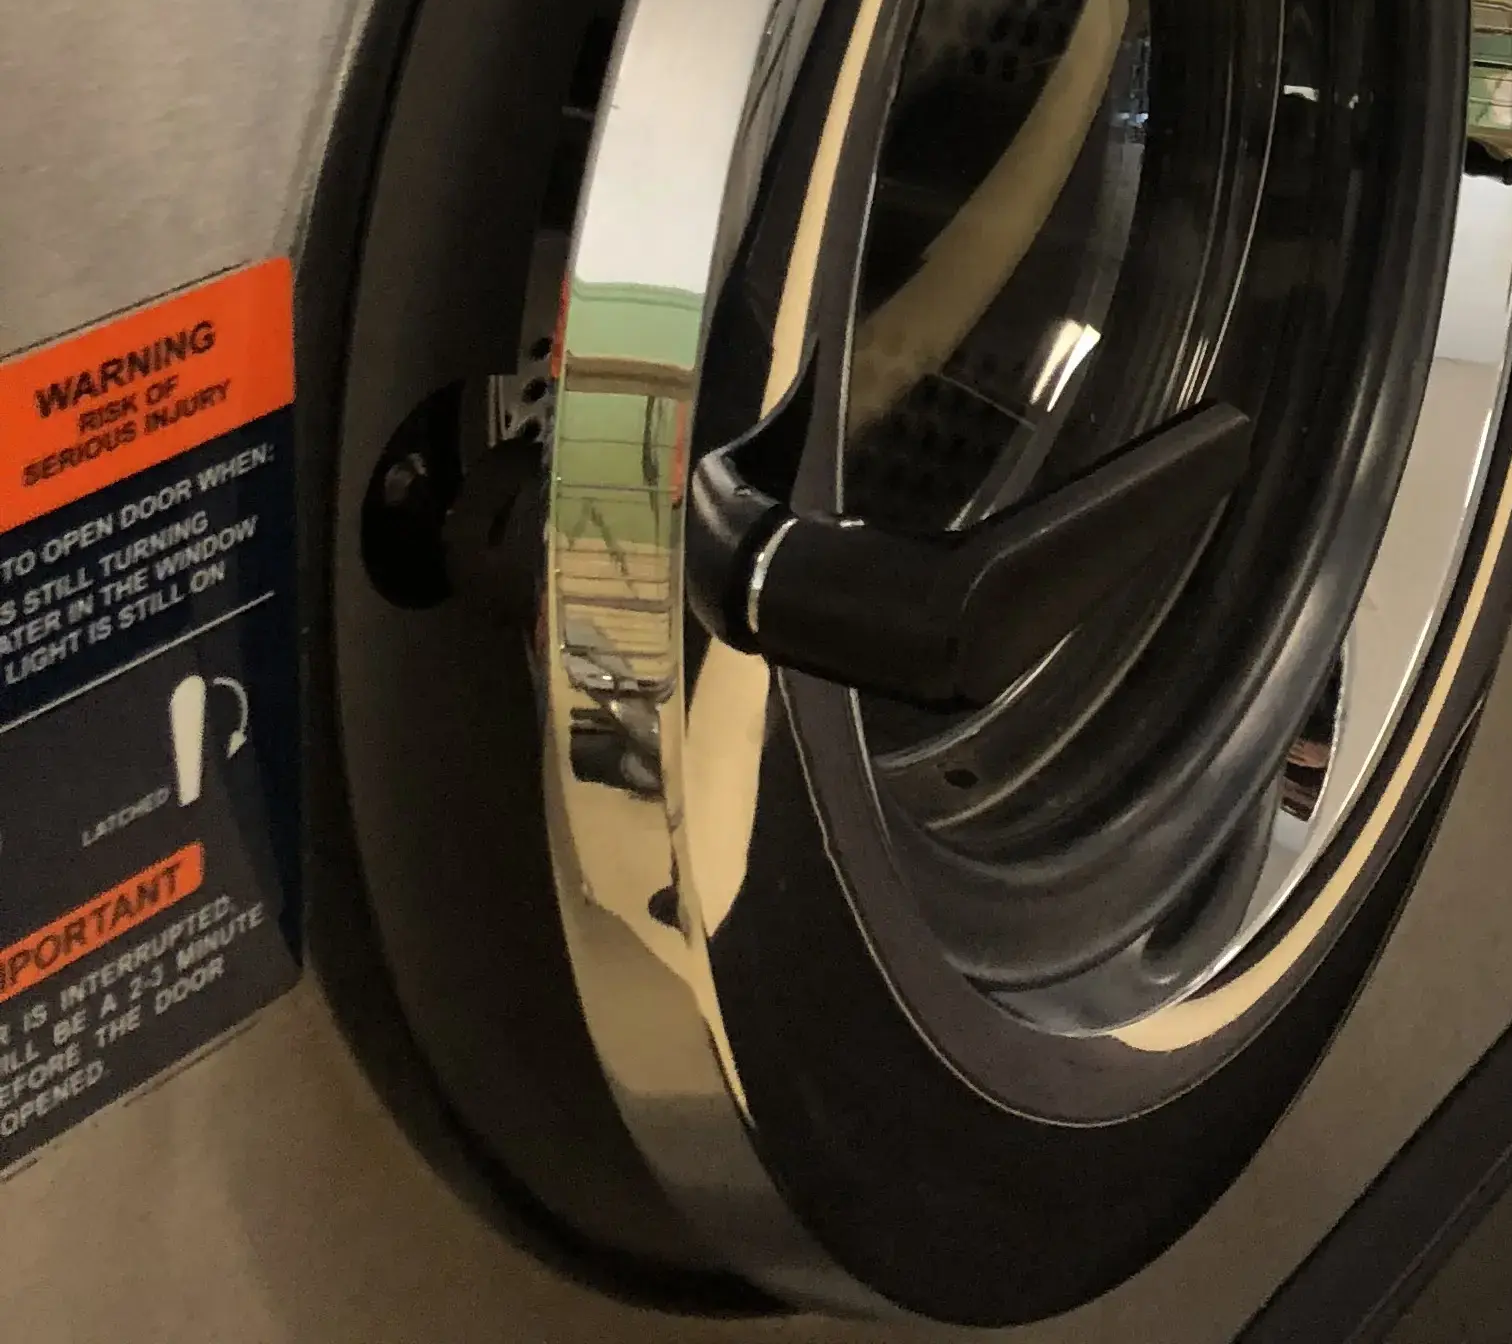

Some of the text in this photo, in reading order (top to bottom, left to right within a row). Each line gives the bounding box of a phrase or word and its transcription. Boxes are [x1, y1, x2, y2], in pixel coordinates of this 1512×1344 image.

[34, 319, 217, 419] WARNING
[79, 375, 179, 435] RISK OF
[22, 377, 230, 487] SERIOUS INJURY
[2, 443, 275, 584] TO OPEN DOOR WHEN:
[23, 510, 209, 615] STILL TURNING
[68, 514, 258, 625] IN THE WINDOW
[5, 560, 226, 685] LIGHT IS STILL ON
[81, 786, 172, 847] LATCHED
[24, 1003, 48, 1033] IS
[53, 900, 265, 1047] BE A 2-3 MINUTE
[95, 1005, 141, 1049] THE
[155, 953, 226, 1015] DOOR
